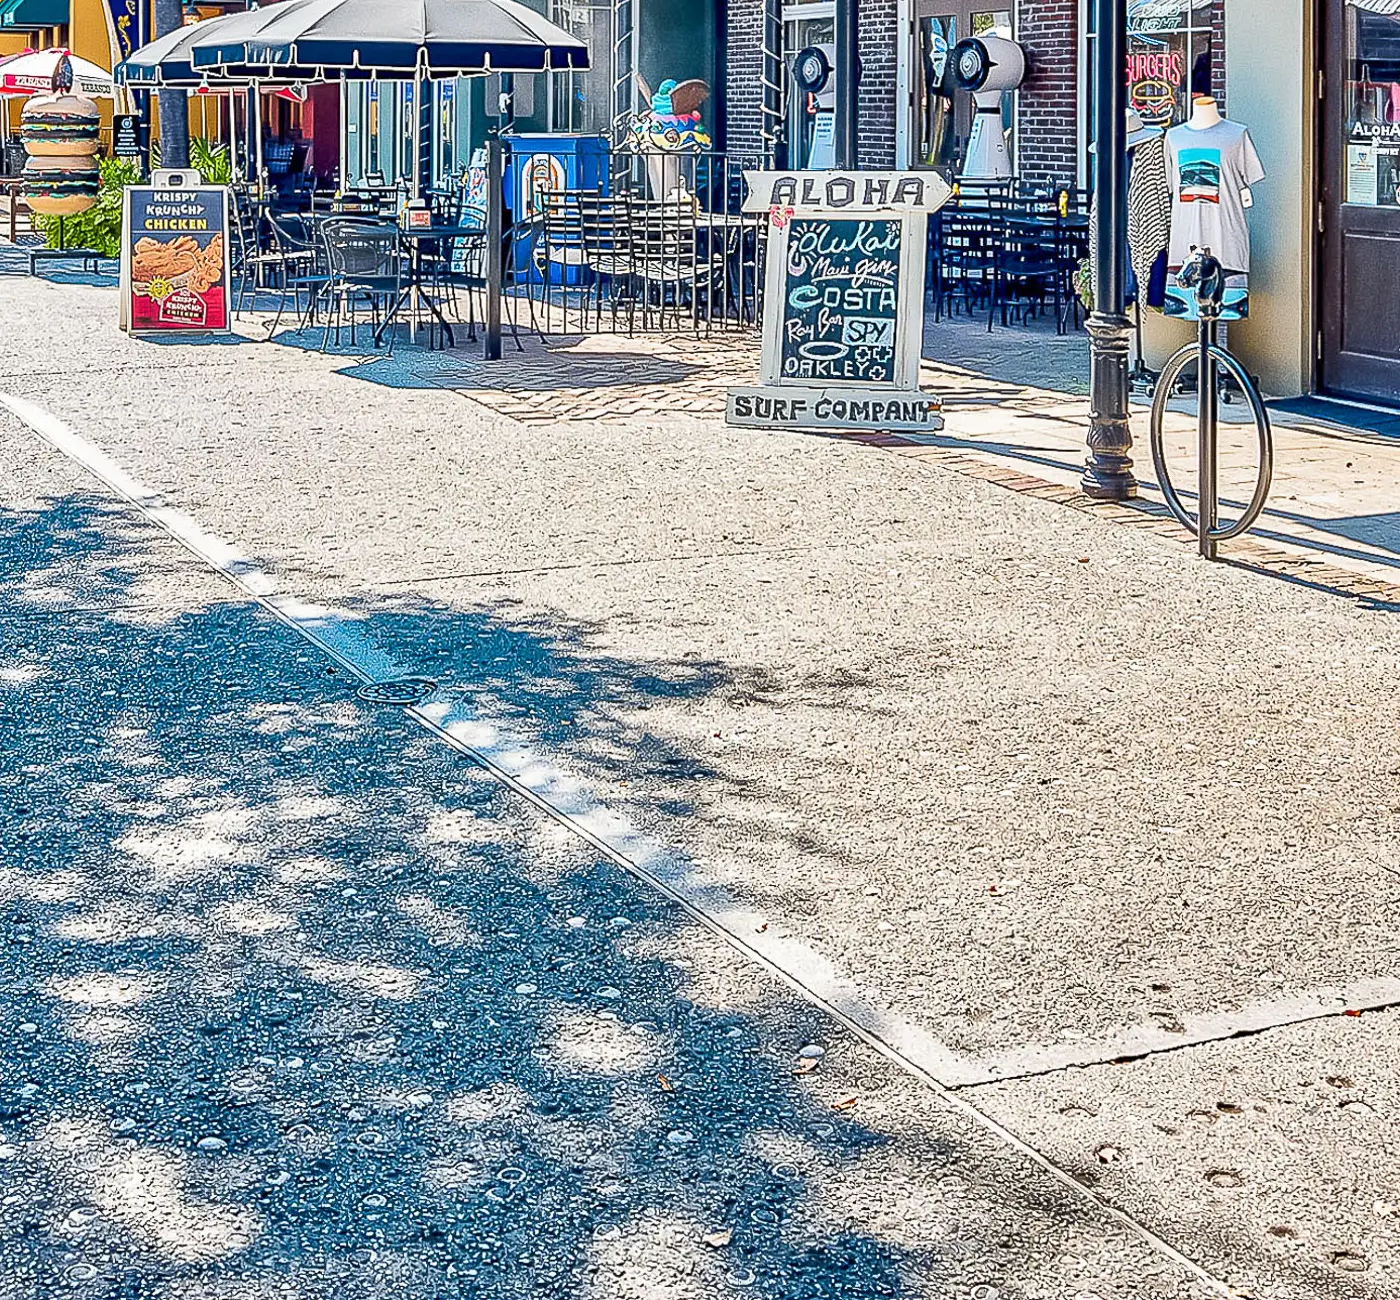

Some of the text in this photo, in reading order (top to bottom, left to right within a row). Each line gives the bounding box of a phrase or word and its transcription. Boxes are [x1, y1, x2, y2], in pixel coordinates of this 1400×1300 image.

[153, 192, 197, 202] KRISPY
[769, 176, 925, 207] ALOHA
[146, 204, 205, 216] KRUNCHY
[144, 219, 208, 230] CHICKEN
[789, 284, 896, 312] COSTA
[785, 320, 814, 343] Ray
[848, 320, 888, 342] SPY
[784, 357, 870, 378] OAKLEY
[735, 396, 931, 423] SURF COMPANY
